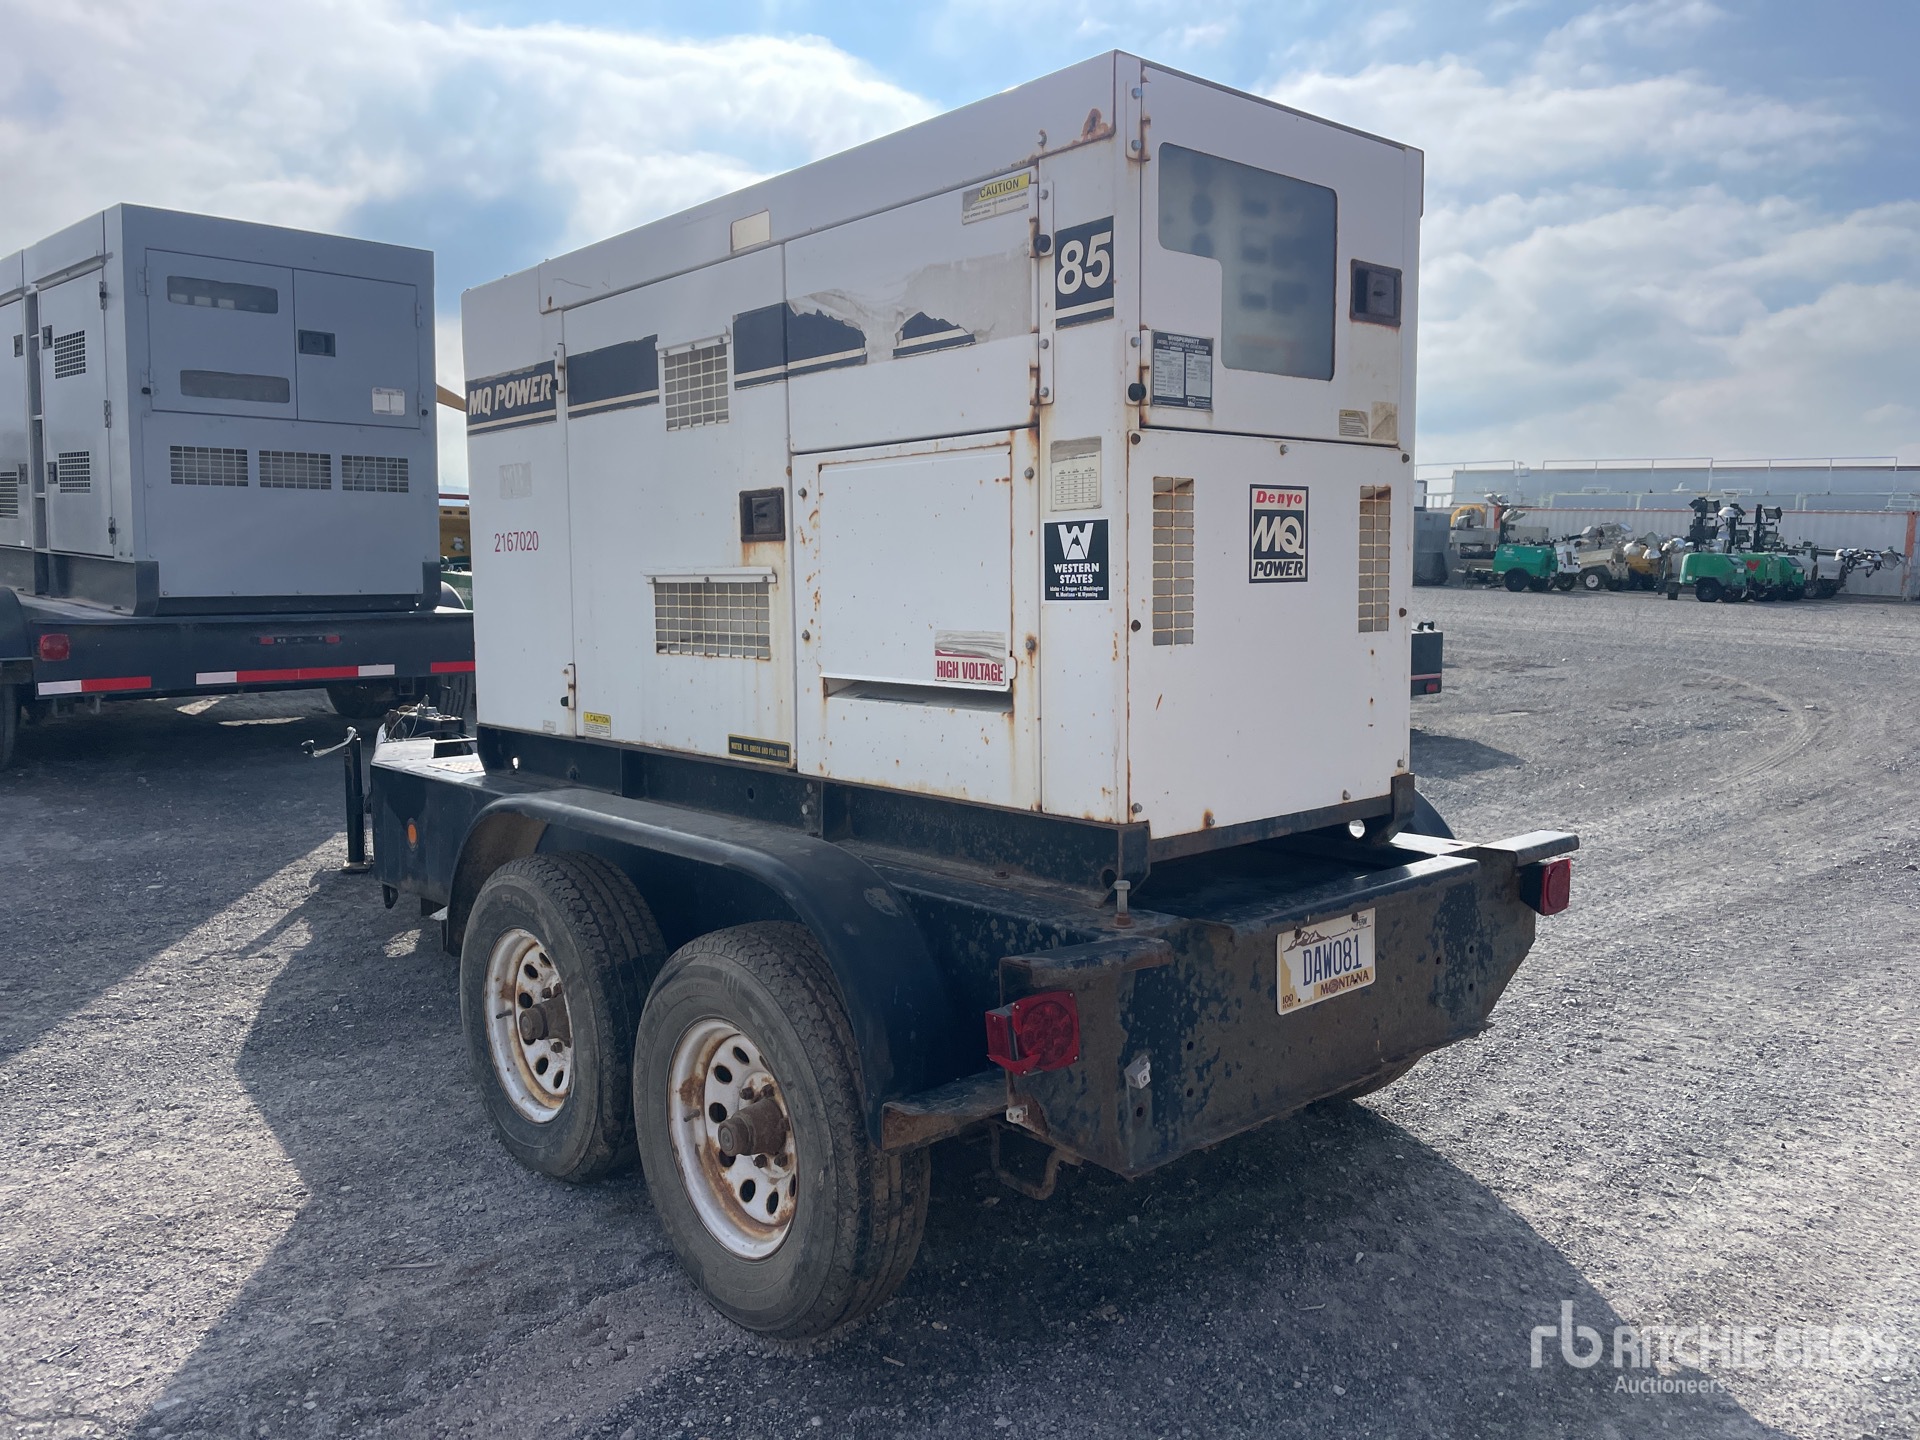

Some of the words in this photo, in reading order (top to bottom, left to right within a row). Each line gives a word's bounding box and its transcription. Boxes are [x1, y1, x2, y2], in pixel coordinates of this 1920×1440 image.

[980, 179, 1020, 198] CAUTION
[1056, 230, 1112, 295] 85
[469, 387, 492, 416] MQ
[494, 373, 553, 410] POWER
[1256, 490, 1302, 508] Denyo
[494, 530, 539, 553] 2167020
[1253, 515, 1304, 556] MQ
[1053, 562, 1100, 573] WESTERN
[1253, 560, 1304, 577] POWER
[1059, 574, 1093, 584] STATES
[936, 660, 959, 679] HIGH
[962, 661, 1004, 682] VOLTAGE
[1320, 969, 1370, 996] MONTANA
[1282, 993, 1294, 1004] 100
